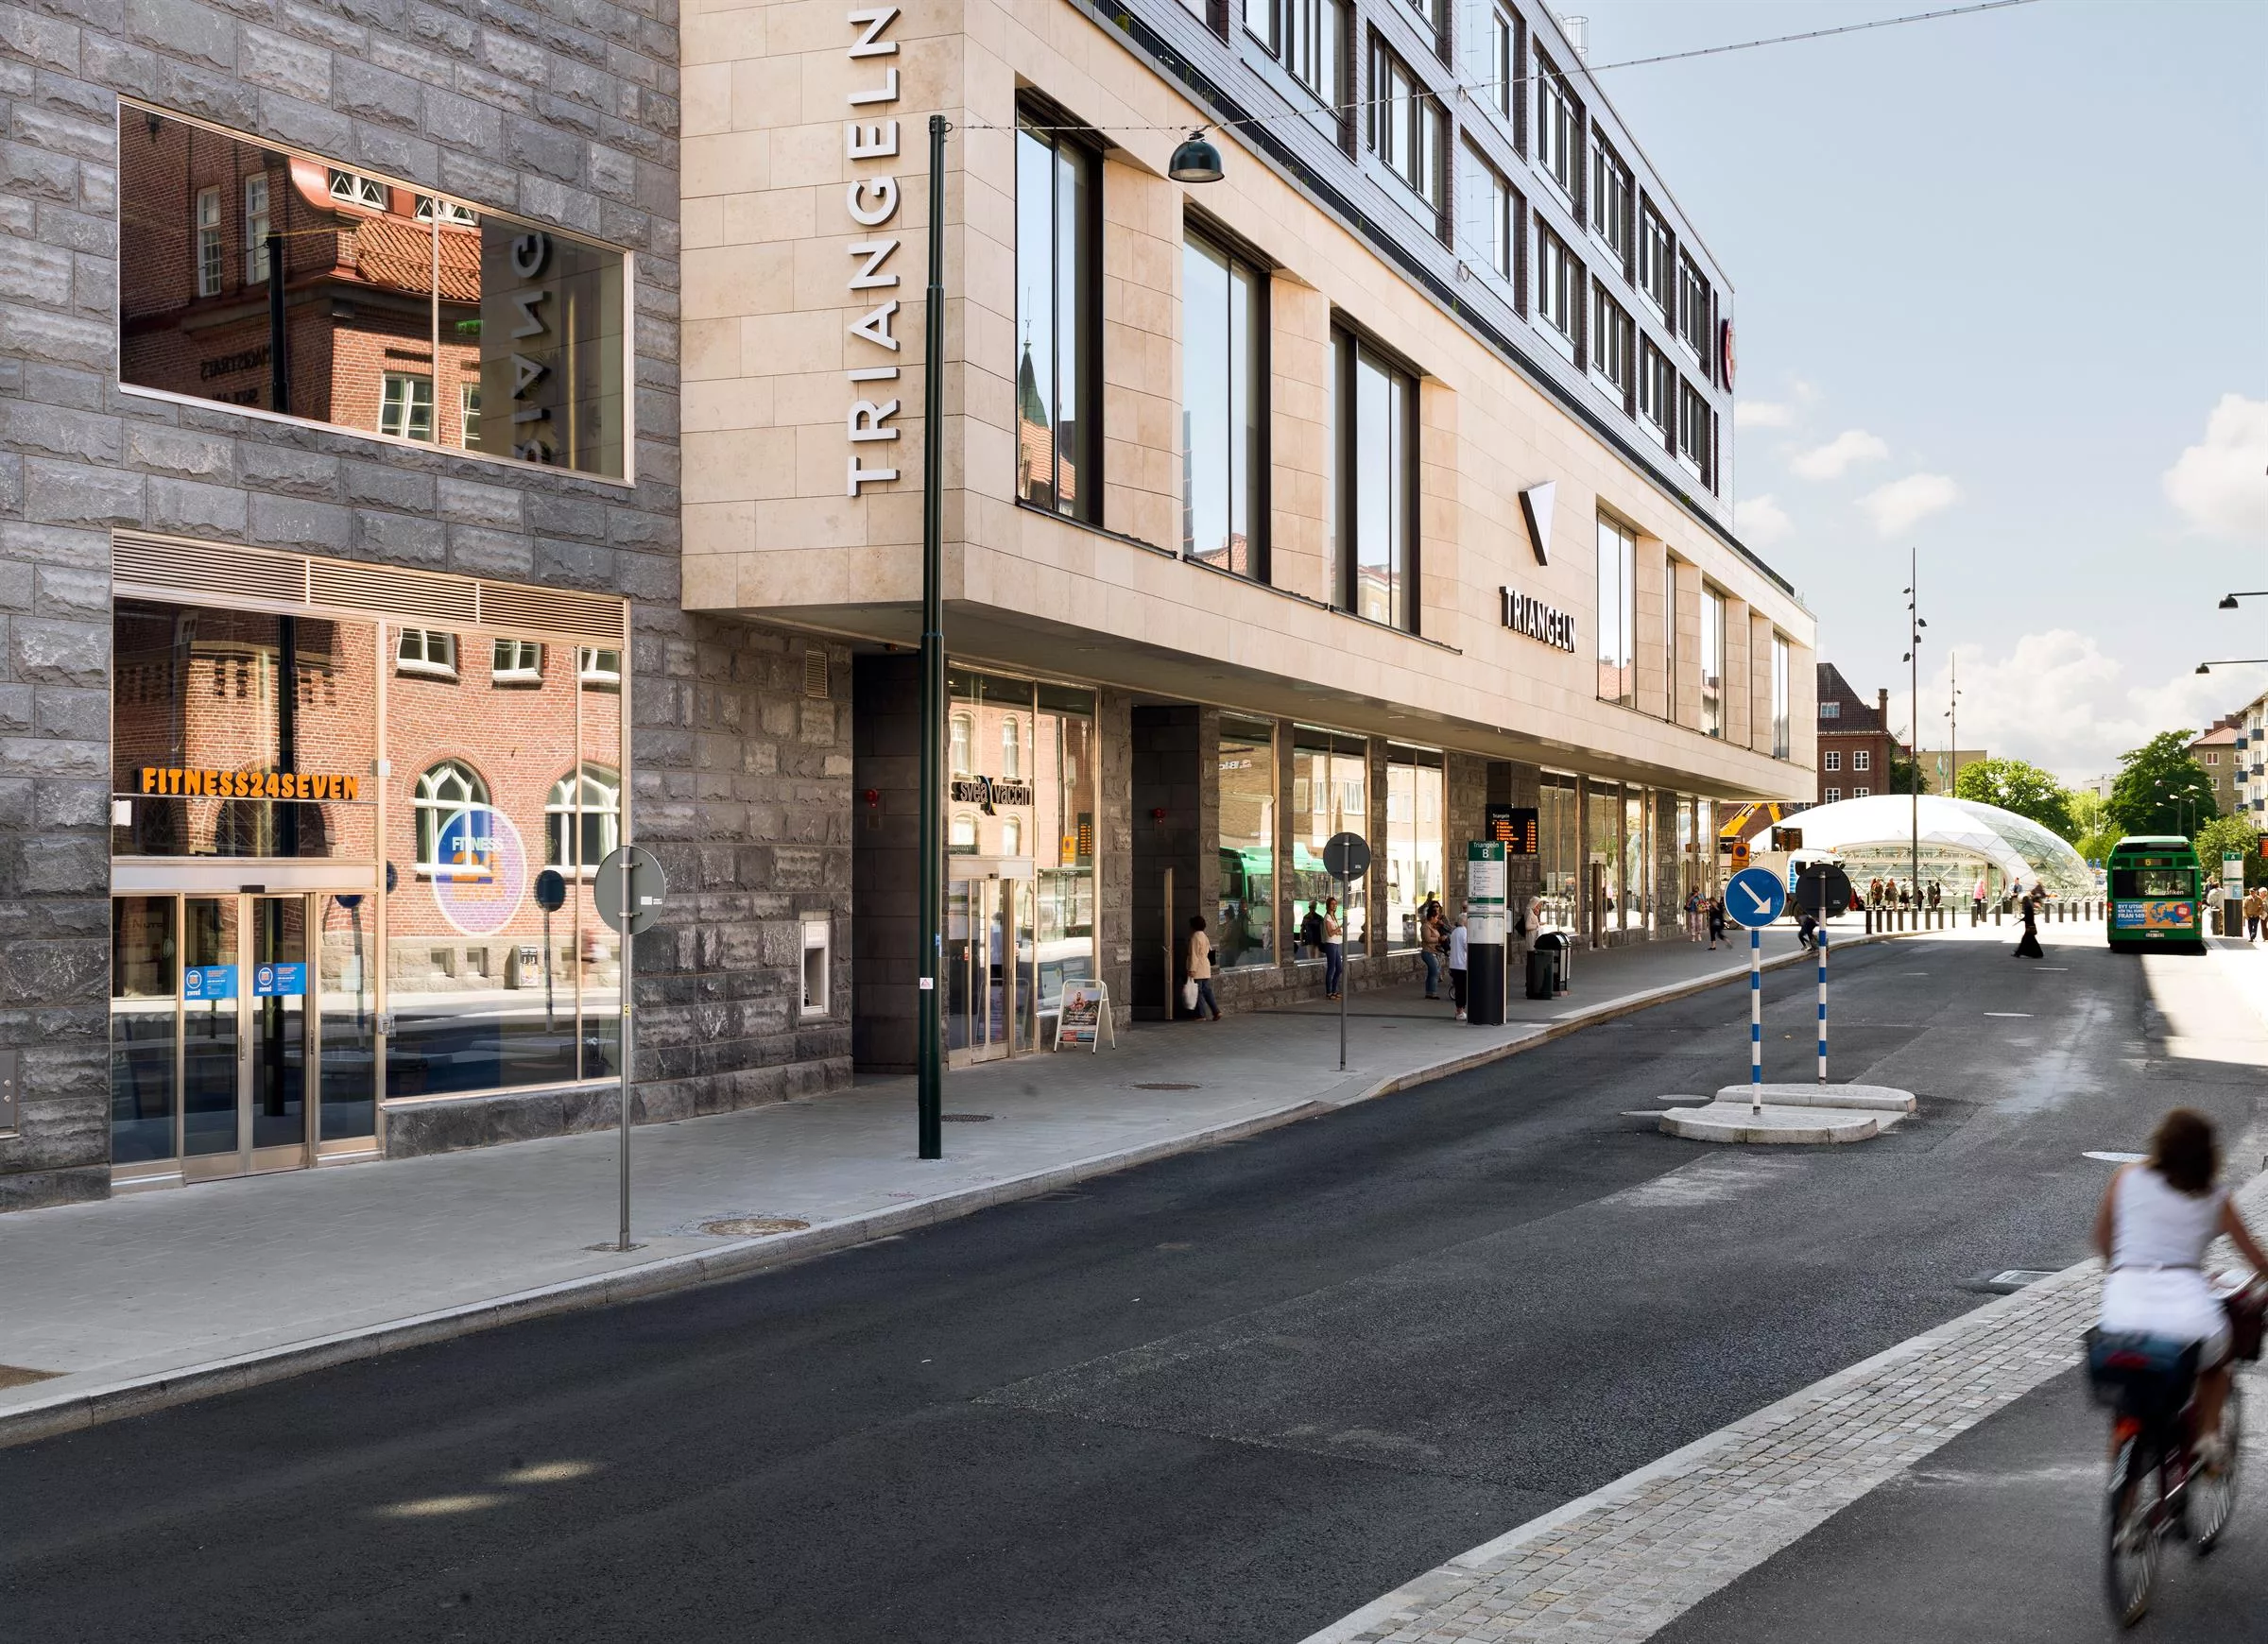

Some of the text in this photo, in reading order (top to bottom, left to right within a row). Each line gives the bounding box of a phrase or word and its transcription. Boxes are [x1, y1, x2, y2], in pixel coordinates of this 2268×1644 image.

[848, 6, 901, 497] TRIANGELN
[1501, 585, 1576, 654] TRIANGELN
[143, 767, 359, 800] FITNESS24SEVEN
[956, 781, 1032, 806] svea vaccin
[452, 836, 505, 851] FINESS
[1482, 849, 1489, 858] B
